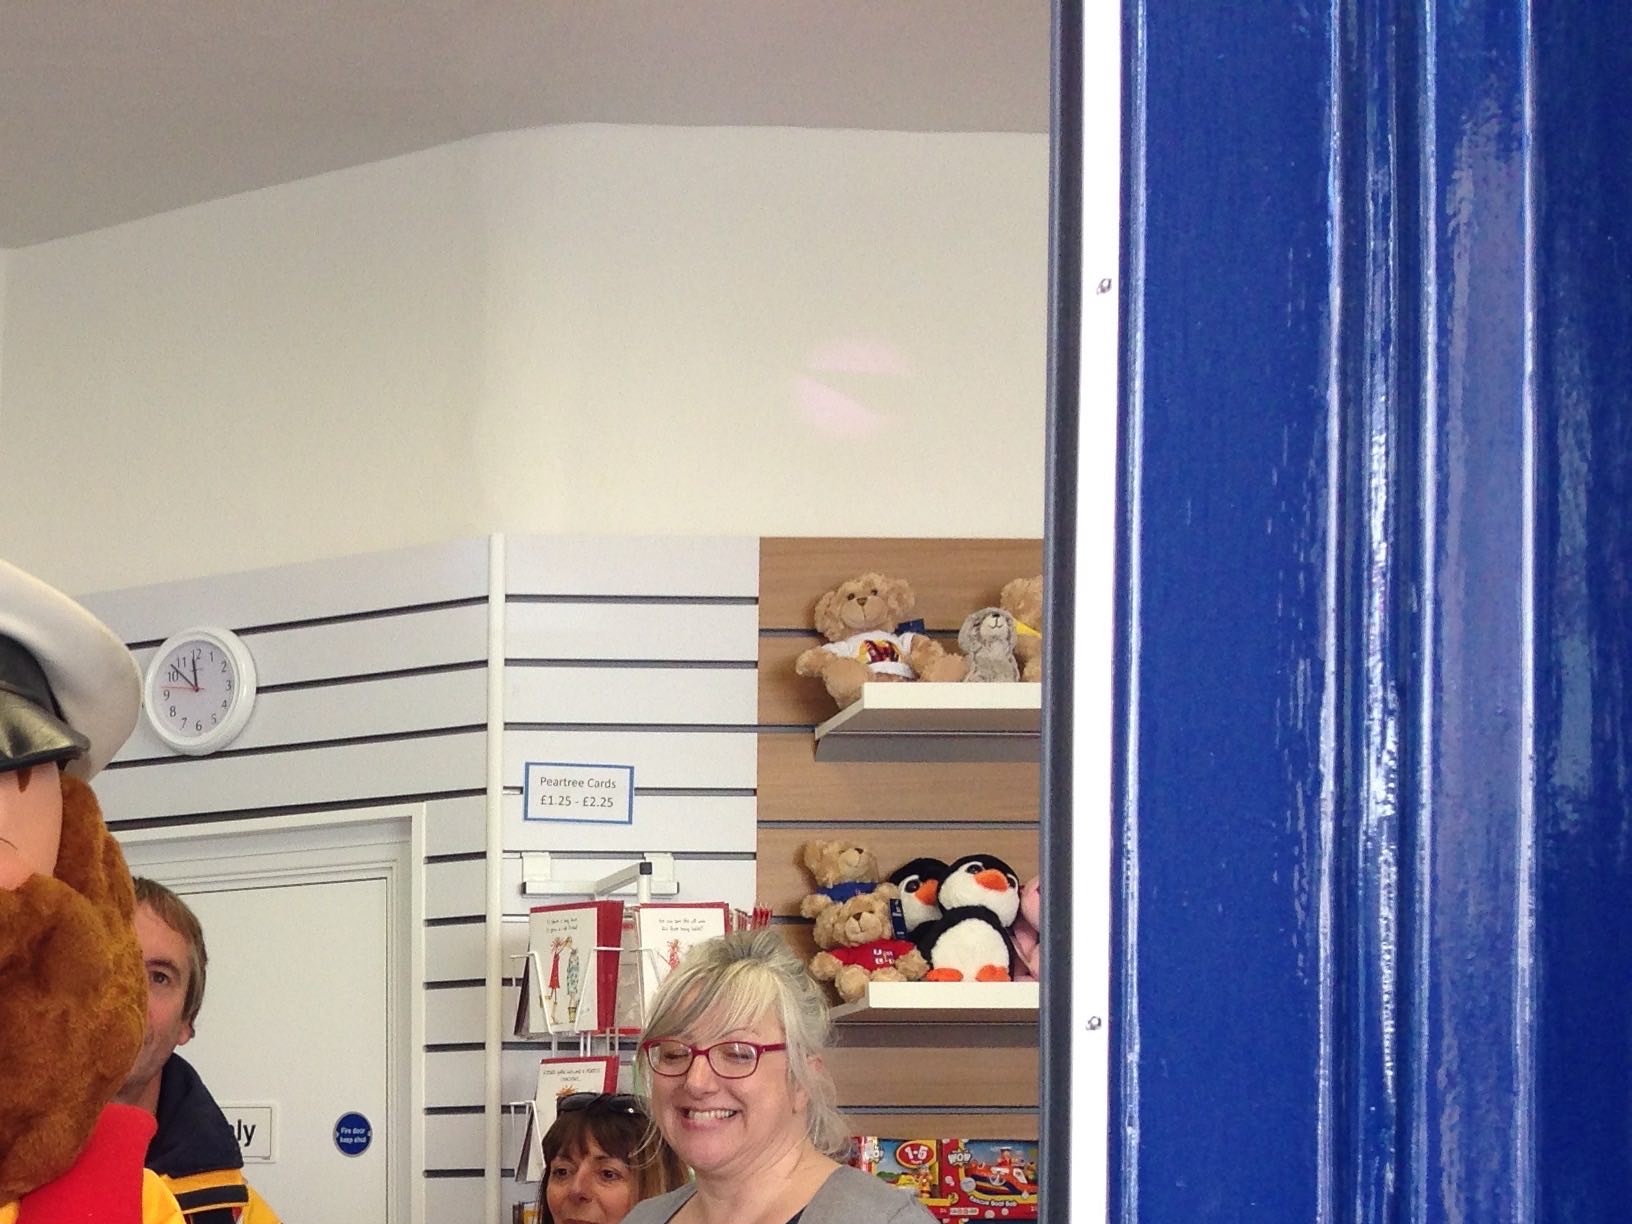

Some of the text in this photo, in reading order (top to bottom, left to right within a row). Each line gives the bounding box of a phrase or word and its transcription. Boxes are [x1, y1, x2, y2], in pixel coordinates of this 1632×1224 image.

[191, 648, 202, 660] 12
[209, 651, 214, 663] 1
[177, 655, 187, 668] 11
[221, 660, 228, 673] 2
[168, 670, 179, 682] 10
[225, 679, 232, 692] 3
[163, 689, 170, 701] 9
[221, 699, 228, 710] 4
[169, 705, 177, 718] 8
[180, 717, 188, 731] 7
[210, 713, 217, 724] 5
[195, 719, 202, 731] 6
[540, 776, 617, 789] Peartree Cards
[540, 795, 572, 807] £1.25
[582, 796, 614, 808] £2.25
